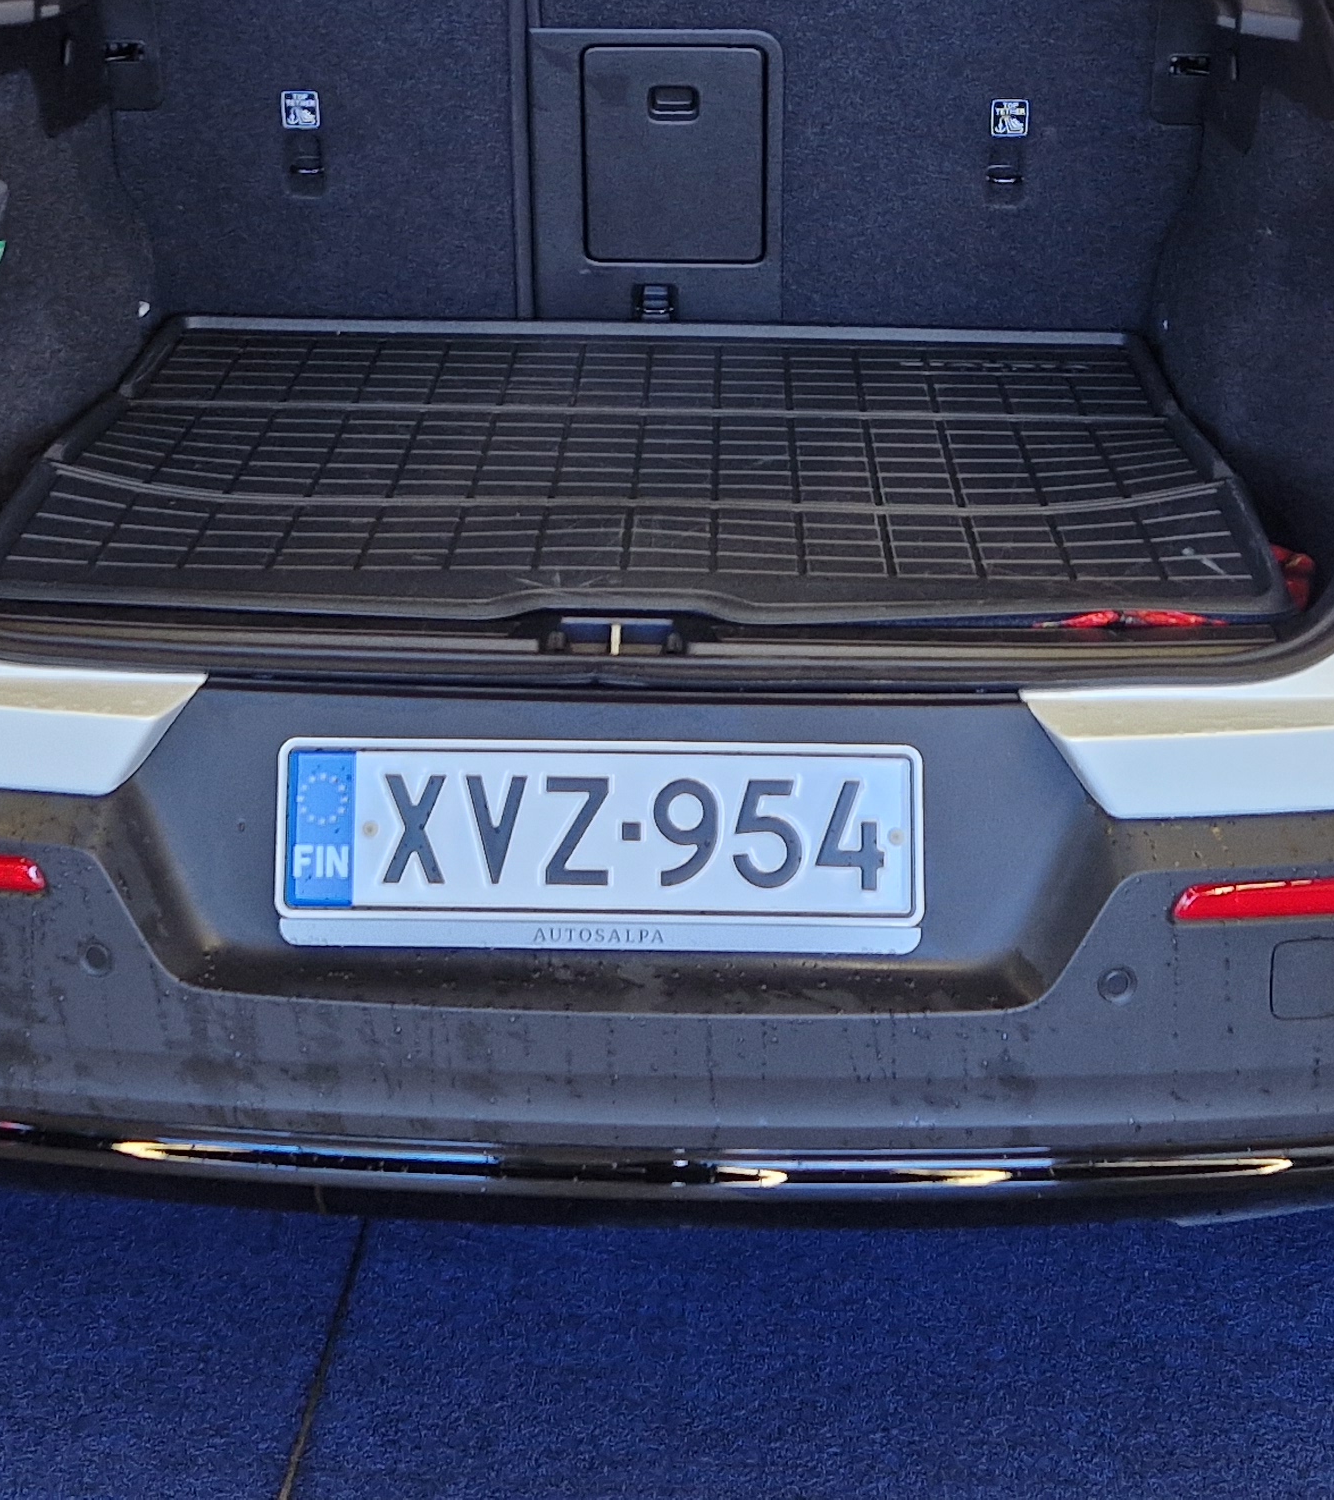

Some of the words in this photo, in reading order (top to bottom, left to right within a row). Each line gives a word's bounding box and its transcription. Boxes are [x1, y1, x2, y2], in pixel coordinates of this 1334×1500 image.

[382, 772, 886, 892] XVZ-954
[291, 843, 350, 879] FIN
[532, 927, 666, 945] AUTOSALPA
